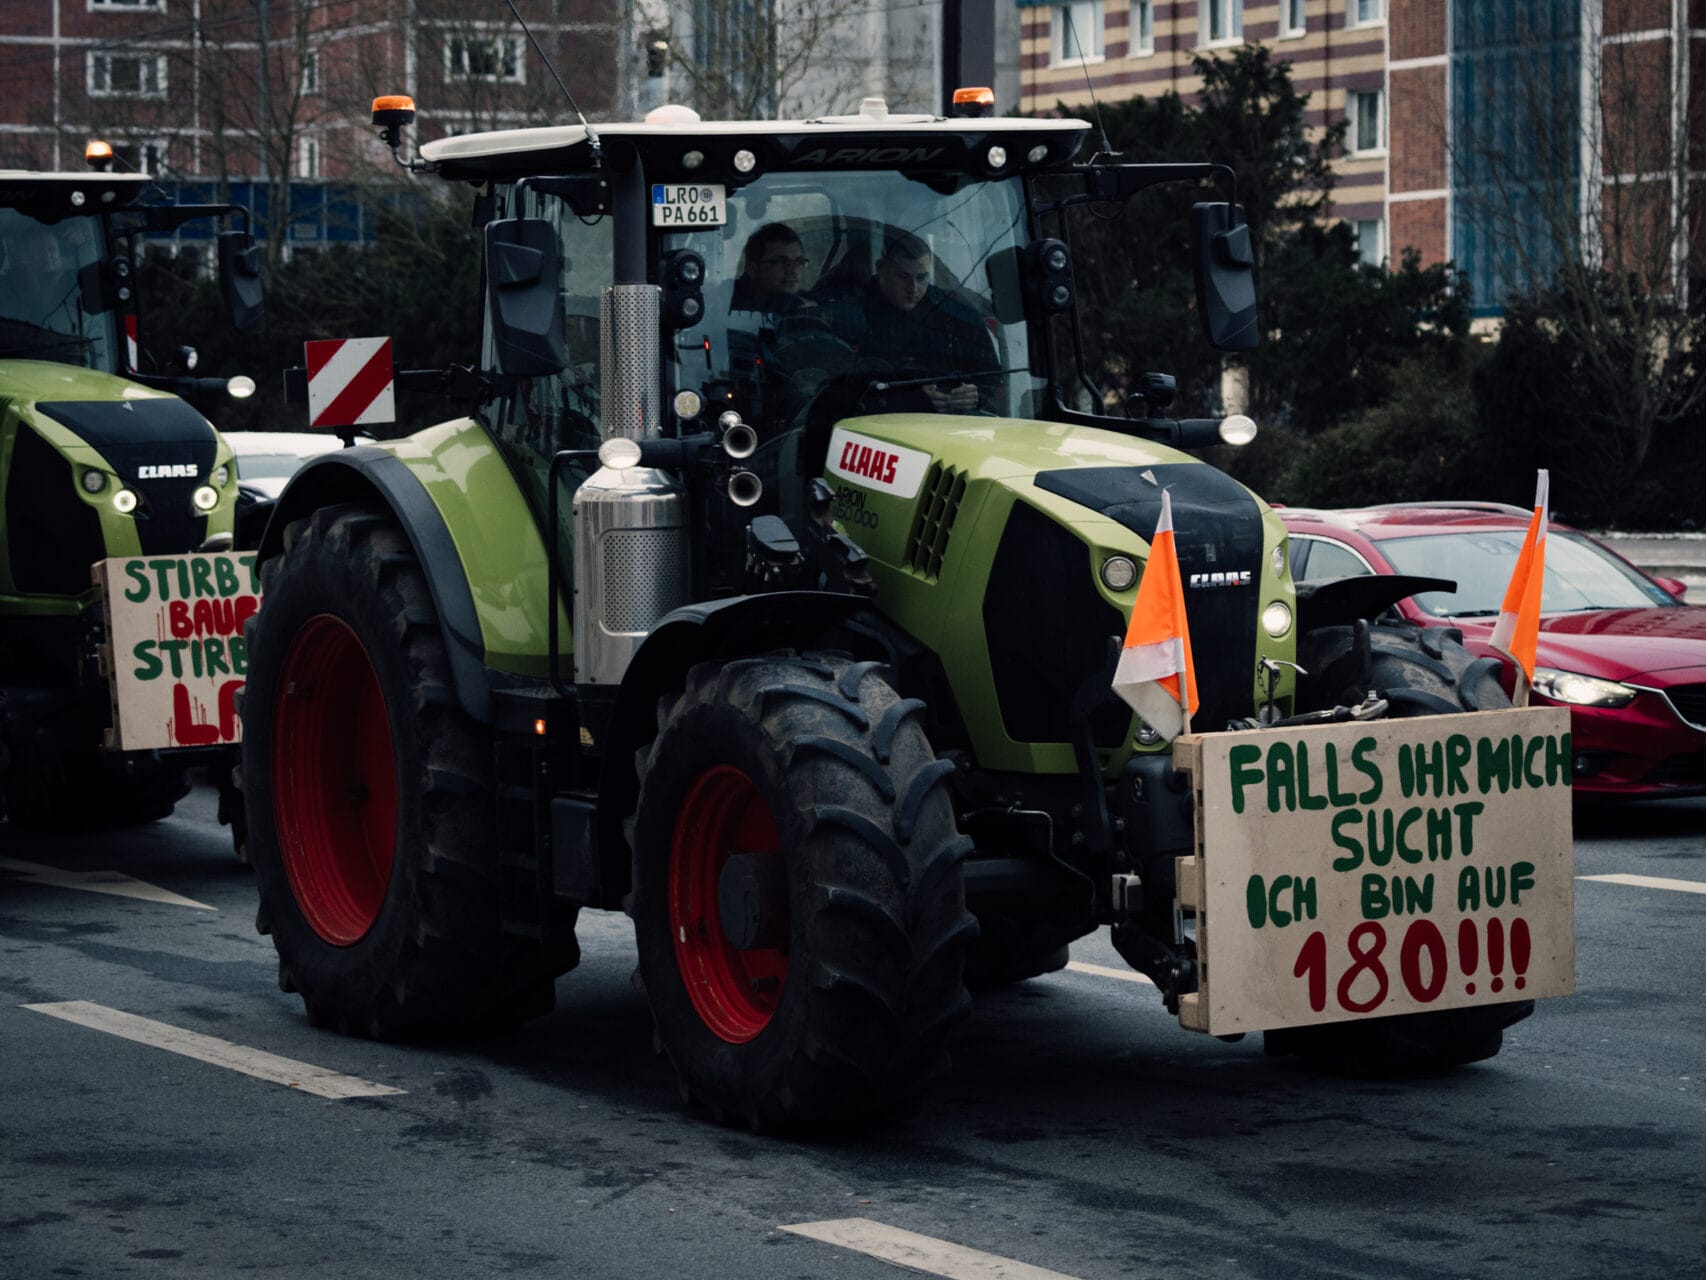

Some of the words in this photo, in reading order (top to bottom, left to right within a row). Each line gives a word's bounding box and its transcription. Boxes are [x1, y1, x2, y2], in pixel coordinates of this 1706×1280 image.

[789, 147, 945, 163] ARION
[665, 187, 699, 204] LRO
[138, 463, 198, 479] CLAAS
[839, 441, 900, 484] CLAAS
[1189, 571, 1251, 588] CLAAS
[1229, 736, 1384, 814] FALLS
[1398, 734, 1472, 798] IHR
[1477, 732, 1572, 794] MICH
[1331, 801, 1485, 872] SUCHT
[1246, 874, 1317, 929] ICH
[1361, 872, 1434, 920] BIN
[1457, 862, 1535, 912] AUF
[1293, 917, 1531, 1013] 180!!!
